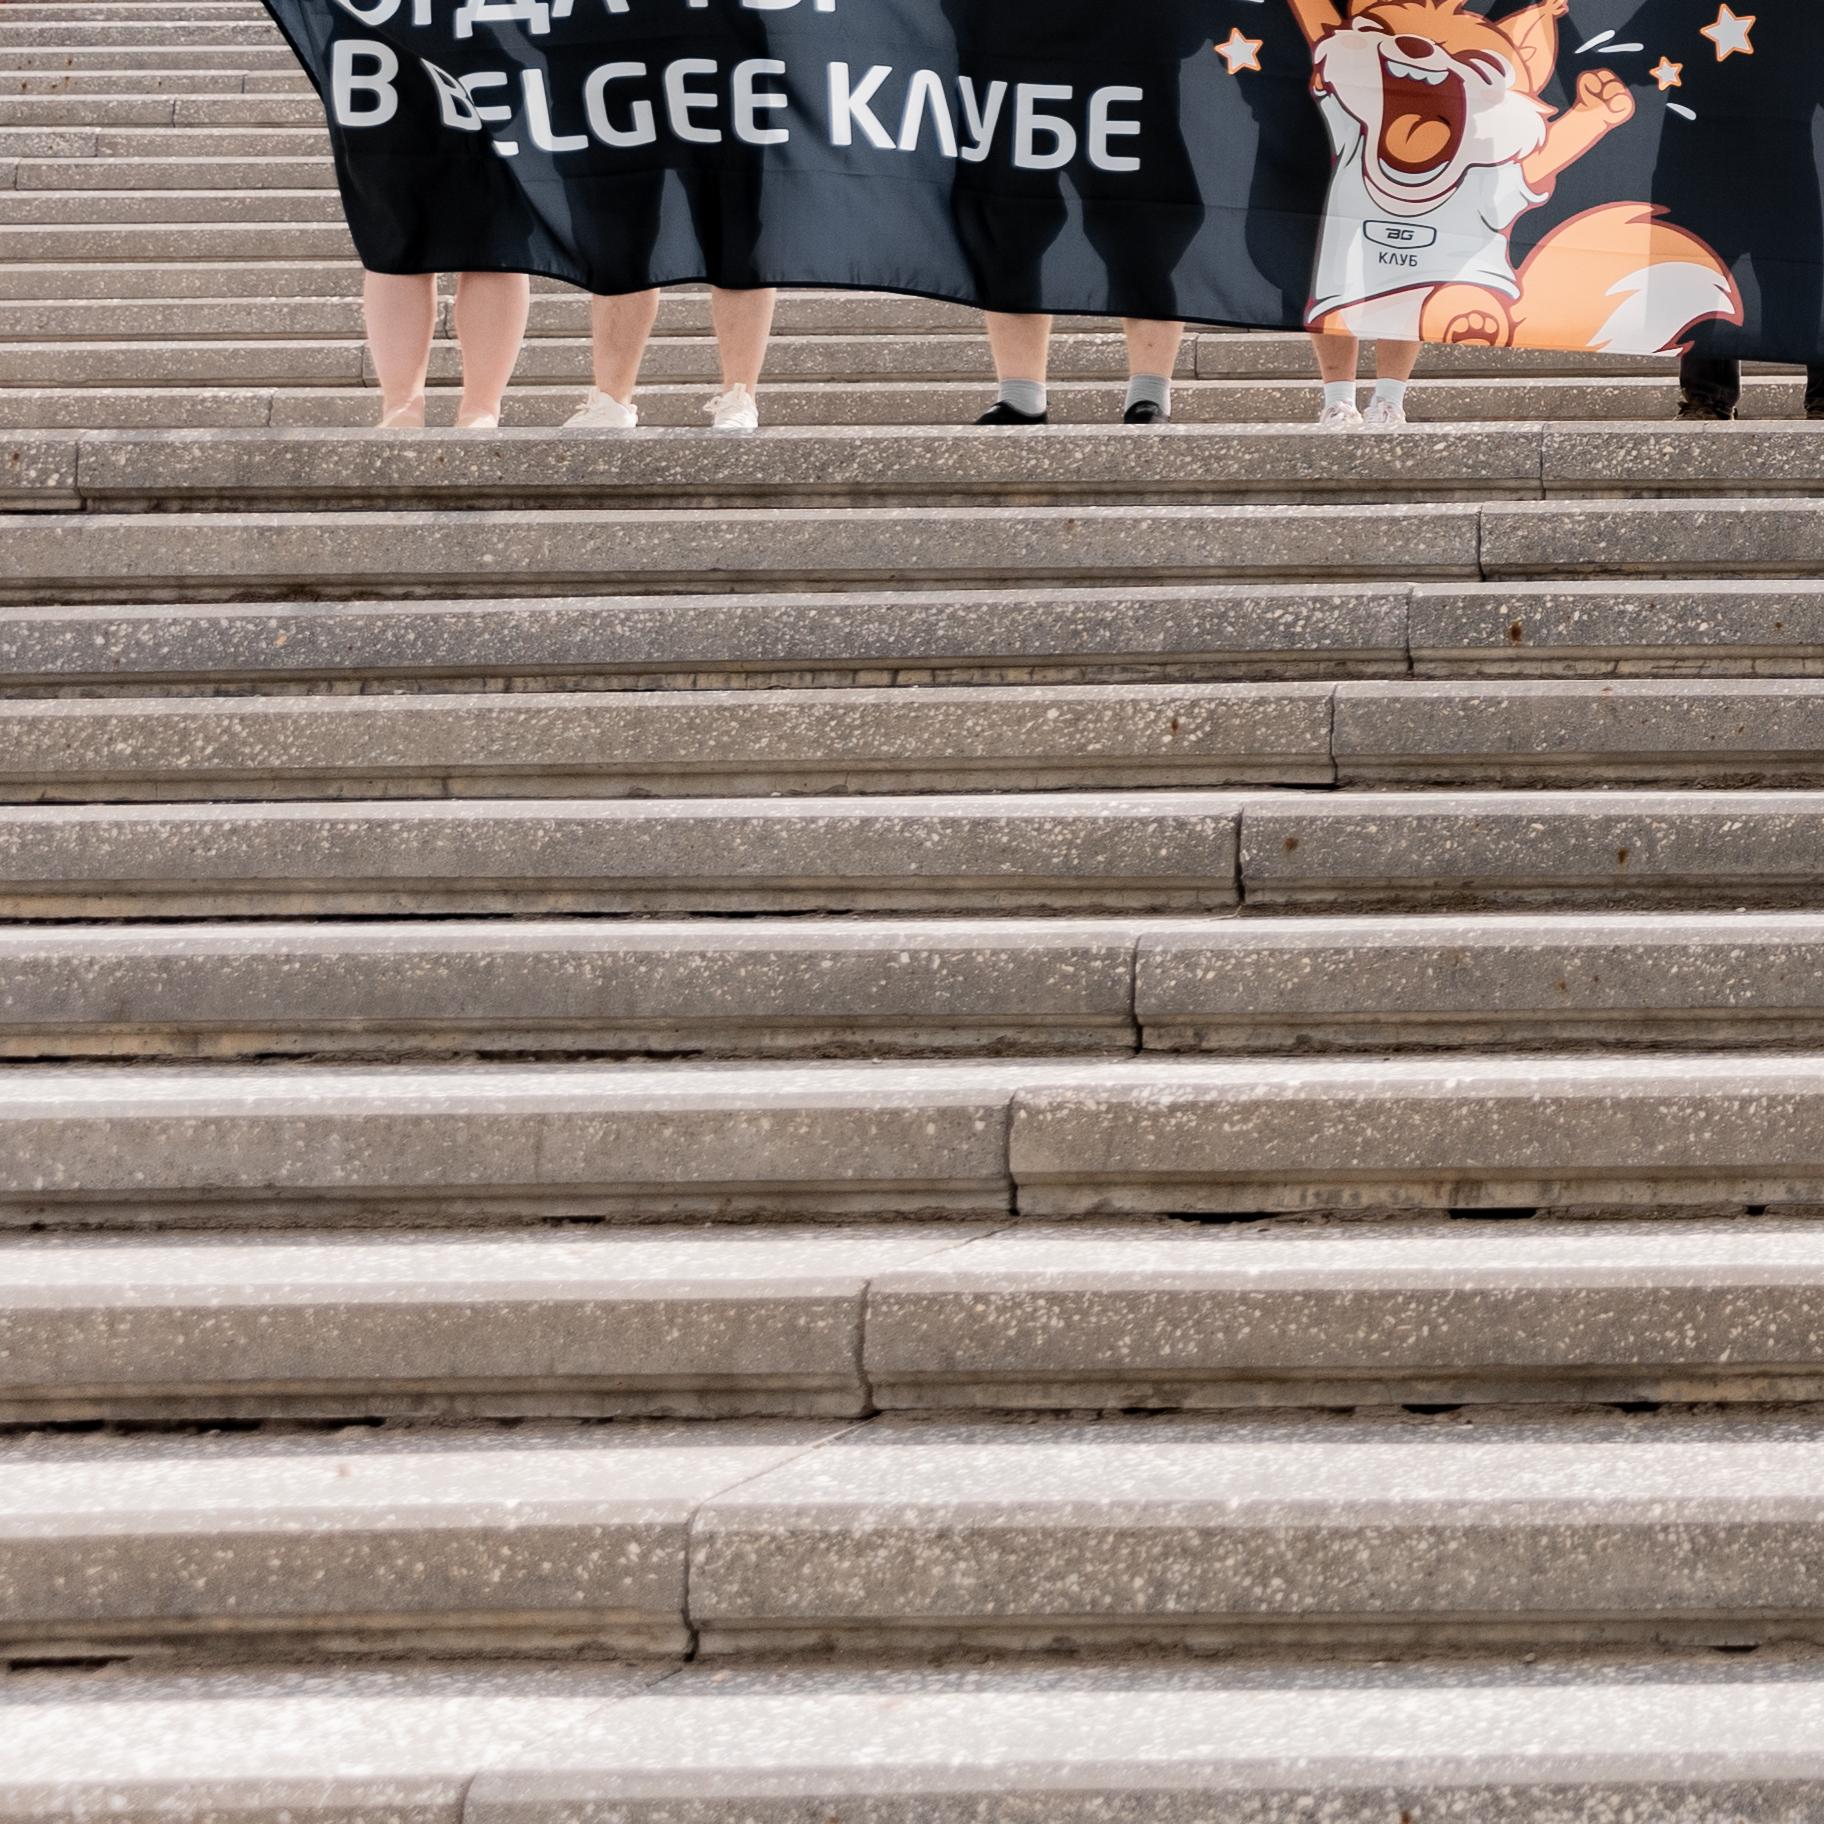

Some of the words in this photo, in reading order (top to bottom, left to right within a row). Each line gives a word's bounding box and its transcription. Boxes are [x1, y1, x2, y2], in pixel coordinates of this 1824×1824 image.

[332, 39, 399, 128] В
[420, 57, 792, 156] BELGEE
[826, 61, 1144, 172] КЛУБЕ
[1378, 251, 1419, 268] КЛУБ
